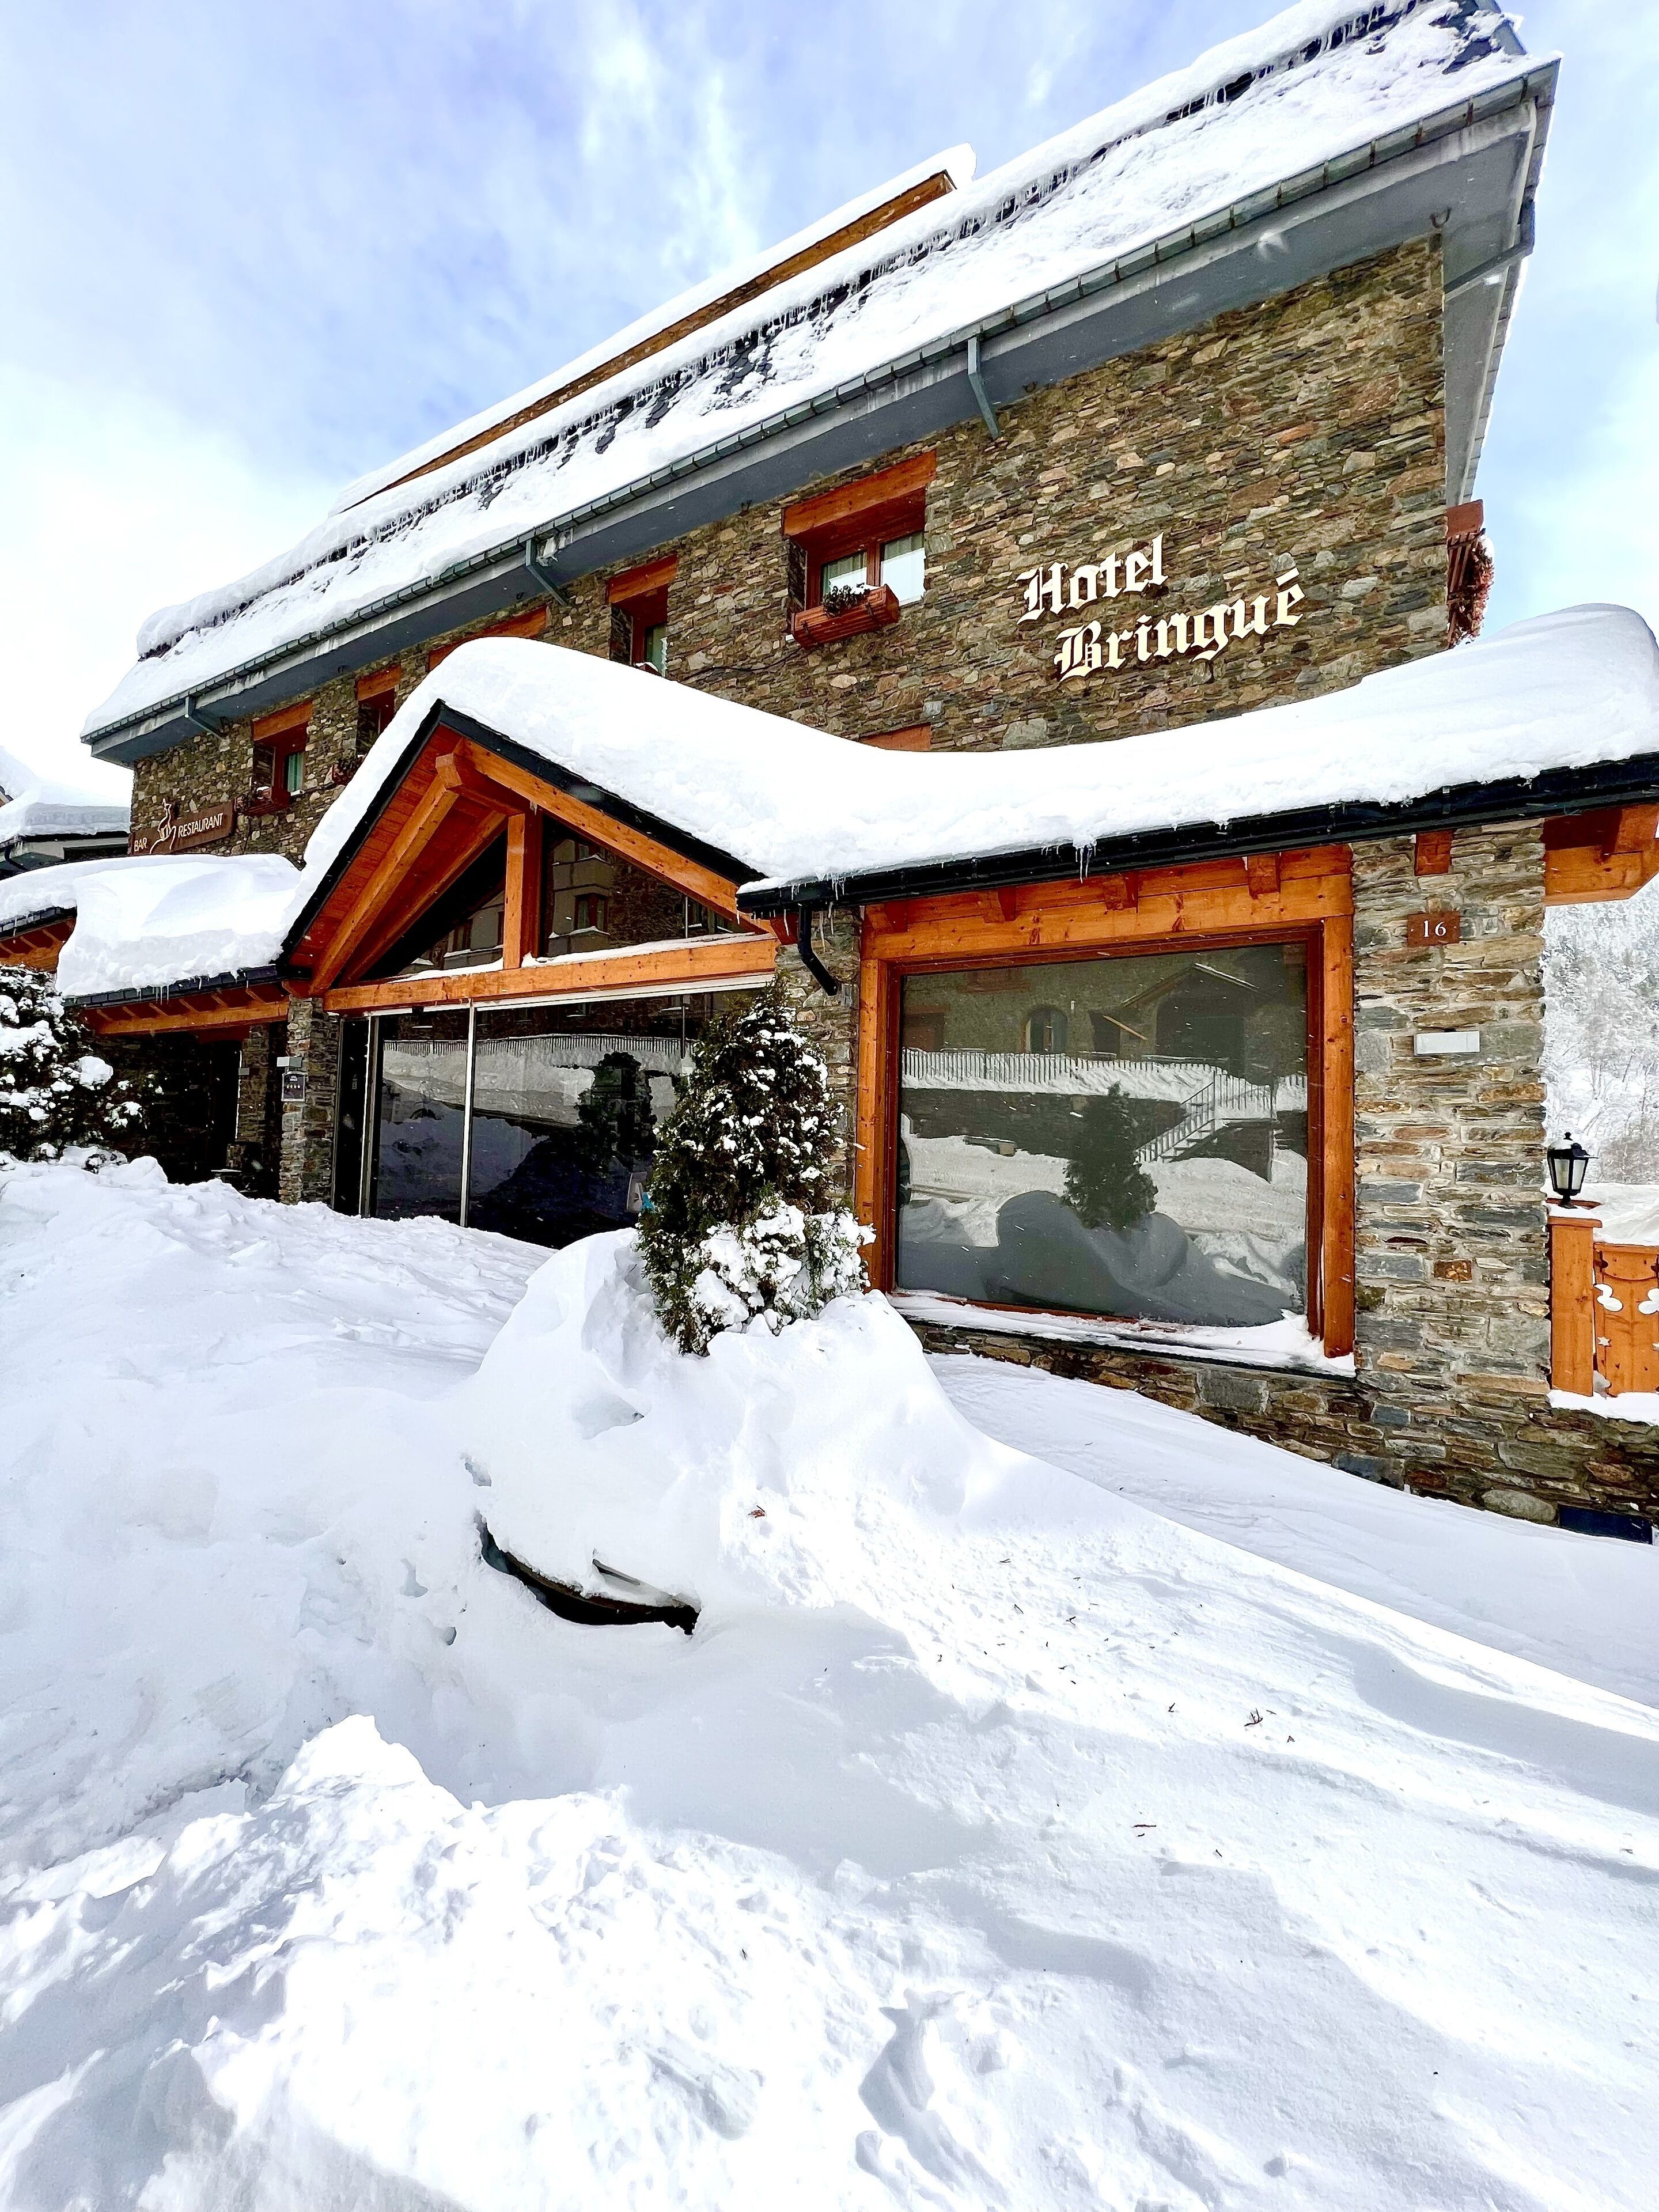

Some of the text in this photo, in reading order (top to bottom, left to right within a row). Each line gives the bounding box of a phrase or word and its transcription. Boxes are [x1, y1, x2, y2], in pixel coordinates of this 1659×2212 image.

[1016, 532, 1168, 624] Hotel
[1054, 567, 1305, 682] Bringué
[134, 813, 224, 852] BAR RESTAURANT
[1423, 920, 1446, 938] 16
